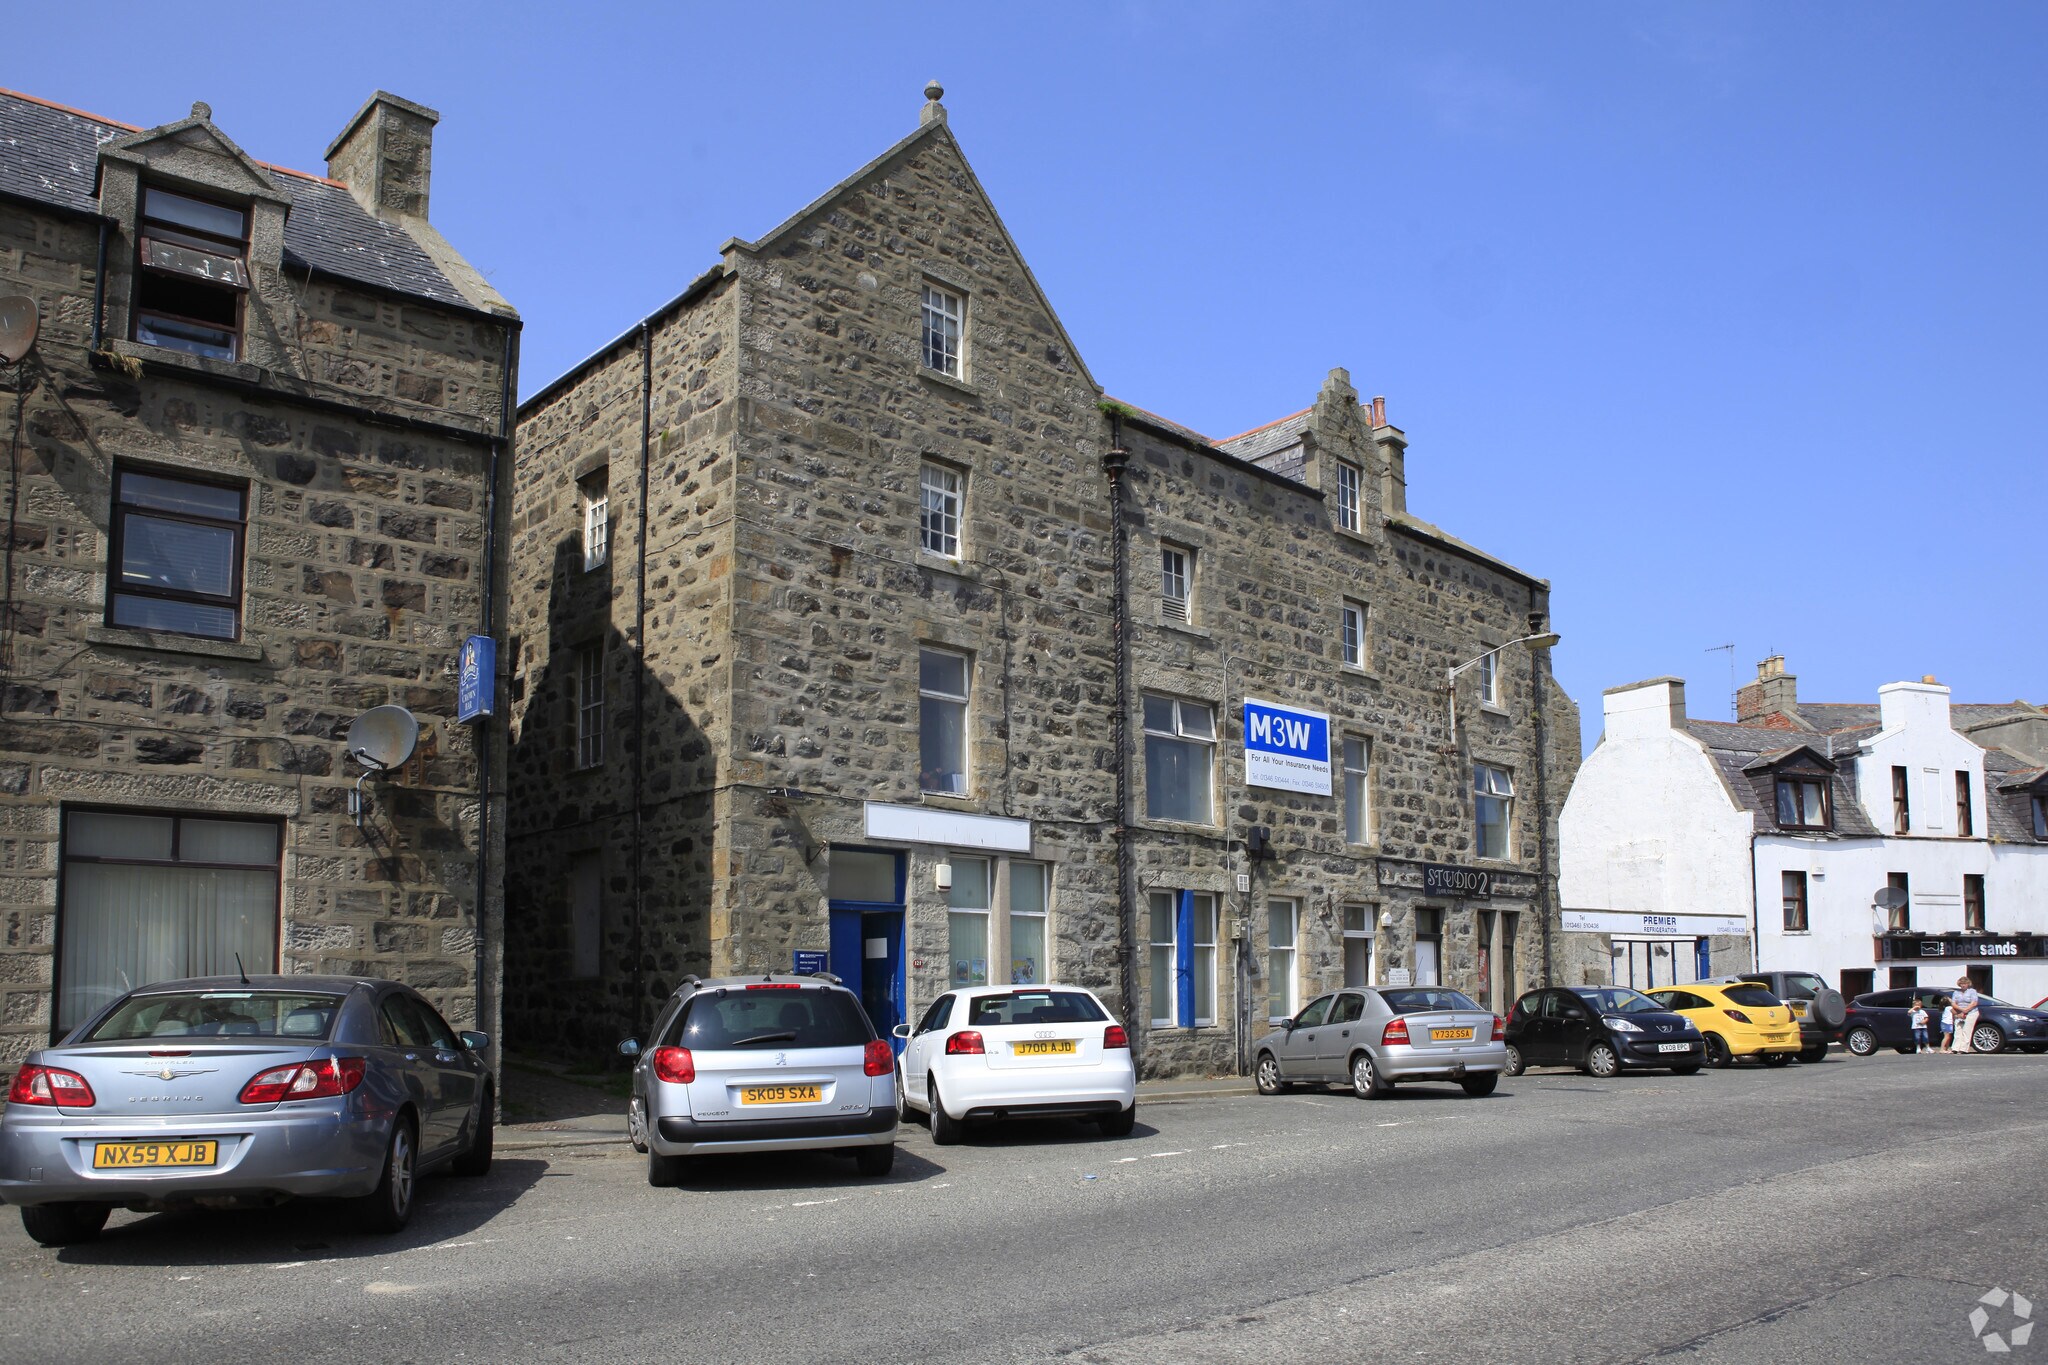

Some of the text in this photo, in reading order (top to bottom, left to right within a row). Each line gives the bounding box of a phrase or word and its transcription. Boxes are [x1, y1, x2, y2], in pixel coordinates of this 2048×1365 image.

[1250, 712, 1310, 751] M3W
[1251, 753, 1261, 762] For
[1271, 757, 1284, 765] Your
[1285, 759, 1311, 770] Insurance
[1312, 764, 1329, 773] Needs
[1643, 916, 1677, 926] PREMIER
[1435, 1029, 1470, 1039] Y732 SSA
[1019, 1040, 1072, 1054] J700 AJD
[128, 1095, 204, 1103] SEBRING
[748, 1086, 816, 1101] SK09 SXA
[103, 1144, 207, 1165] NX59 XJB
